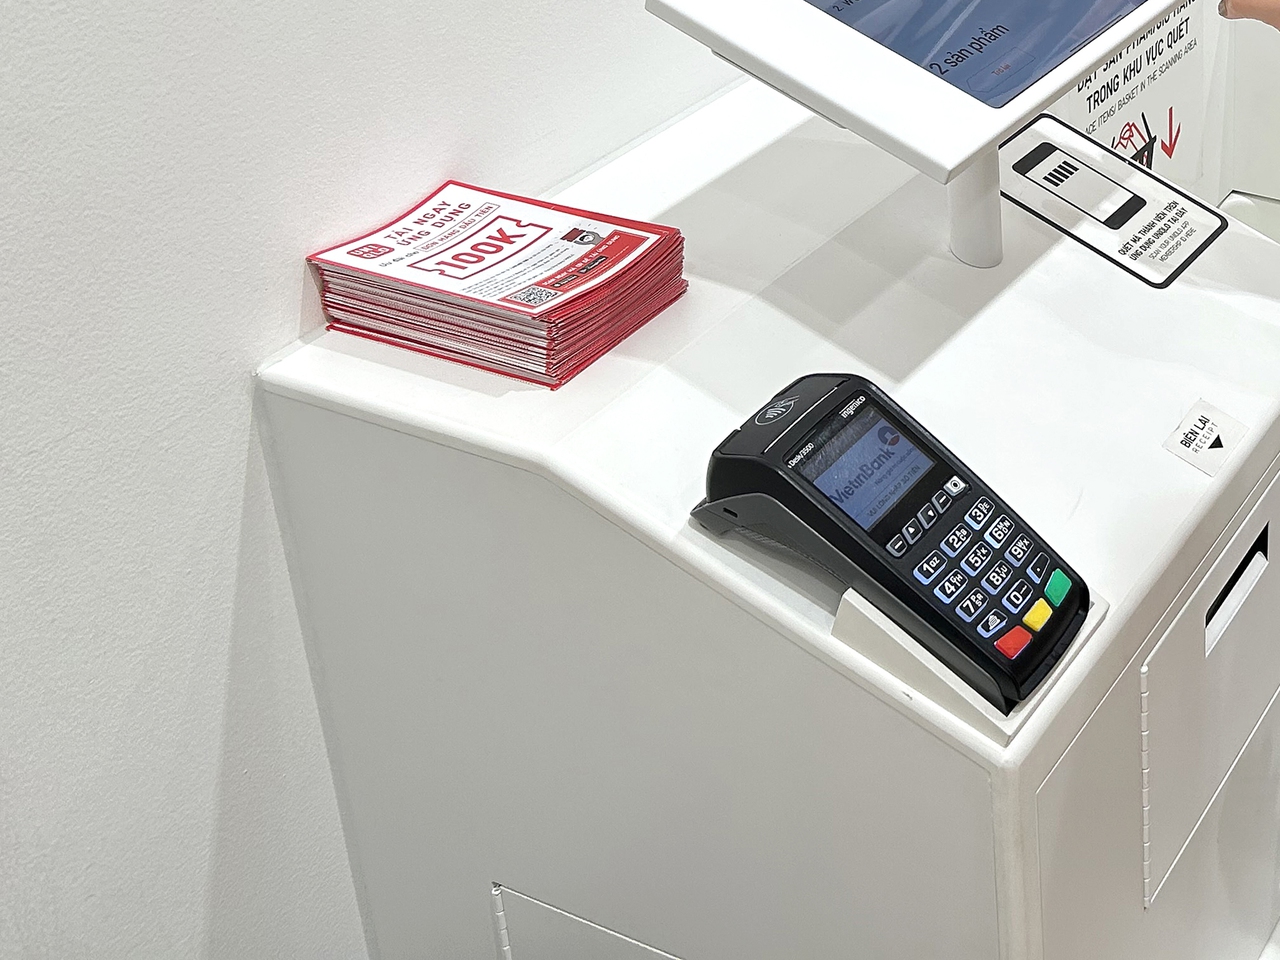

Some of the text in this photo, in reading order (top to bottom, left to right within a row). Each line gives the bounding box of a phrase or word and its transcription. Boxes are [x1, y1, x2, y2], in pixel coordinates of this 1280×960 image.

[928, 23, 1010, 76] 2 sản phẩm
[1086, 16, 1190, 114] TRONG KHU VỰC QUÉT
[1116, 84, 1139, 111] BASKET
[1140, 80, 1146, 92] IN
[1147, 69, 1158, 84] THE
[1159, 50, 1182, 76] SCANNING
[1184, 38, 1197, 55] AREA
[412, 200, 451, 226] NGAY
[431, 203, 471, 228] DỤNG
[434, 227, 527, 270] 100K
[840, 396, 866, 418] ingenico
[1194, 414, 1210, 431] LAI
[1192, 422, 1218, 454] RECEIPT
[789, 442, 814, 468] Desk/3500
[829, 446, 896, 504] VietinBank
[972, 509, 983, 521] 3
[949, 536, 961, 548] 2
[992, 528, 1004, 540] 6
[1012, 546, 1024, 559] 9
[922, 563, 934, 574] 1
[968, 556, 980, 568] 5
[989, 573, 1001, 586] 8
[944, 584, 956, 595] 4
[1010, 591, 1022, 604] 0
[962, 601, 975, 614] 7
